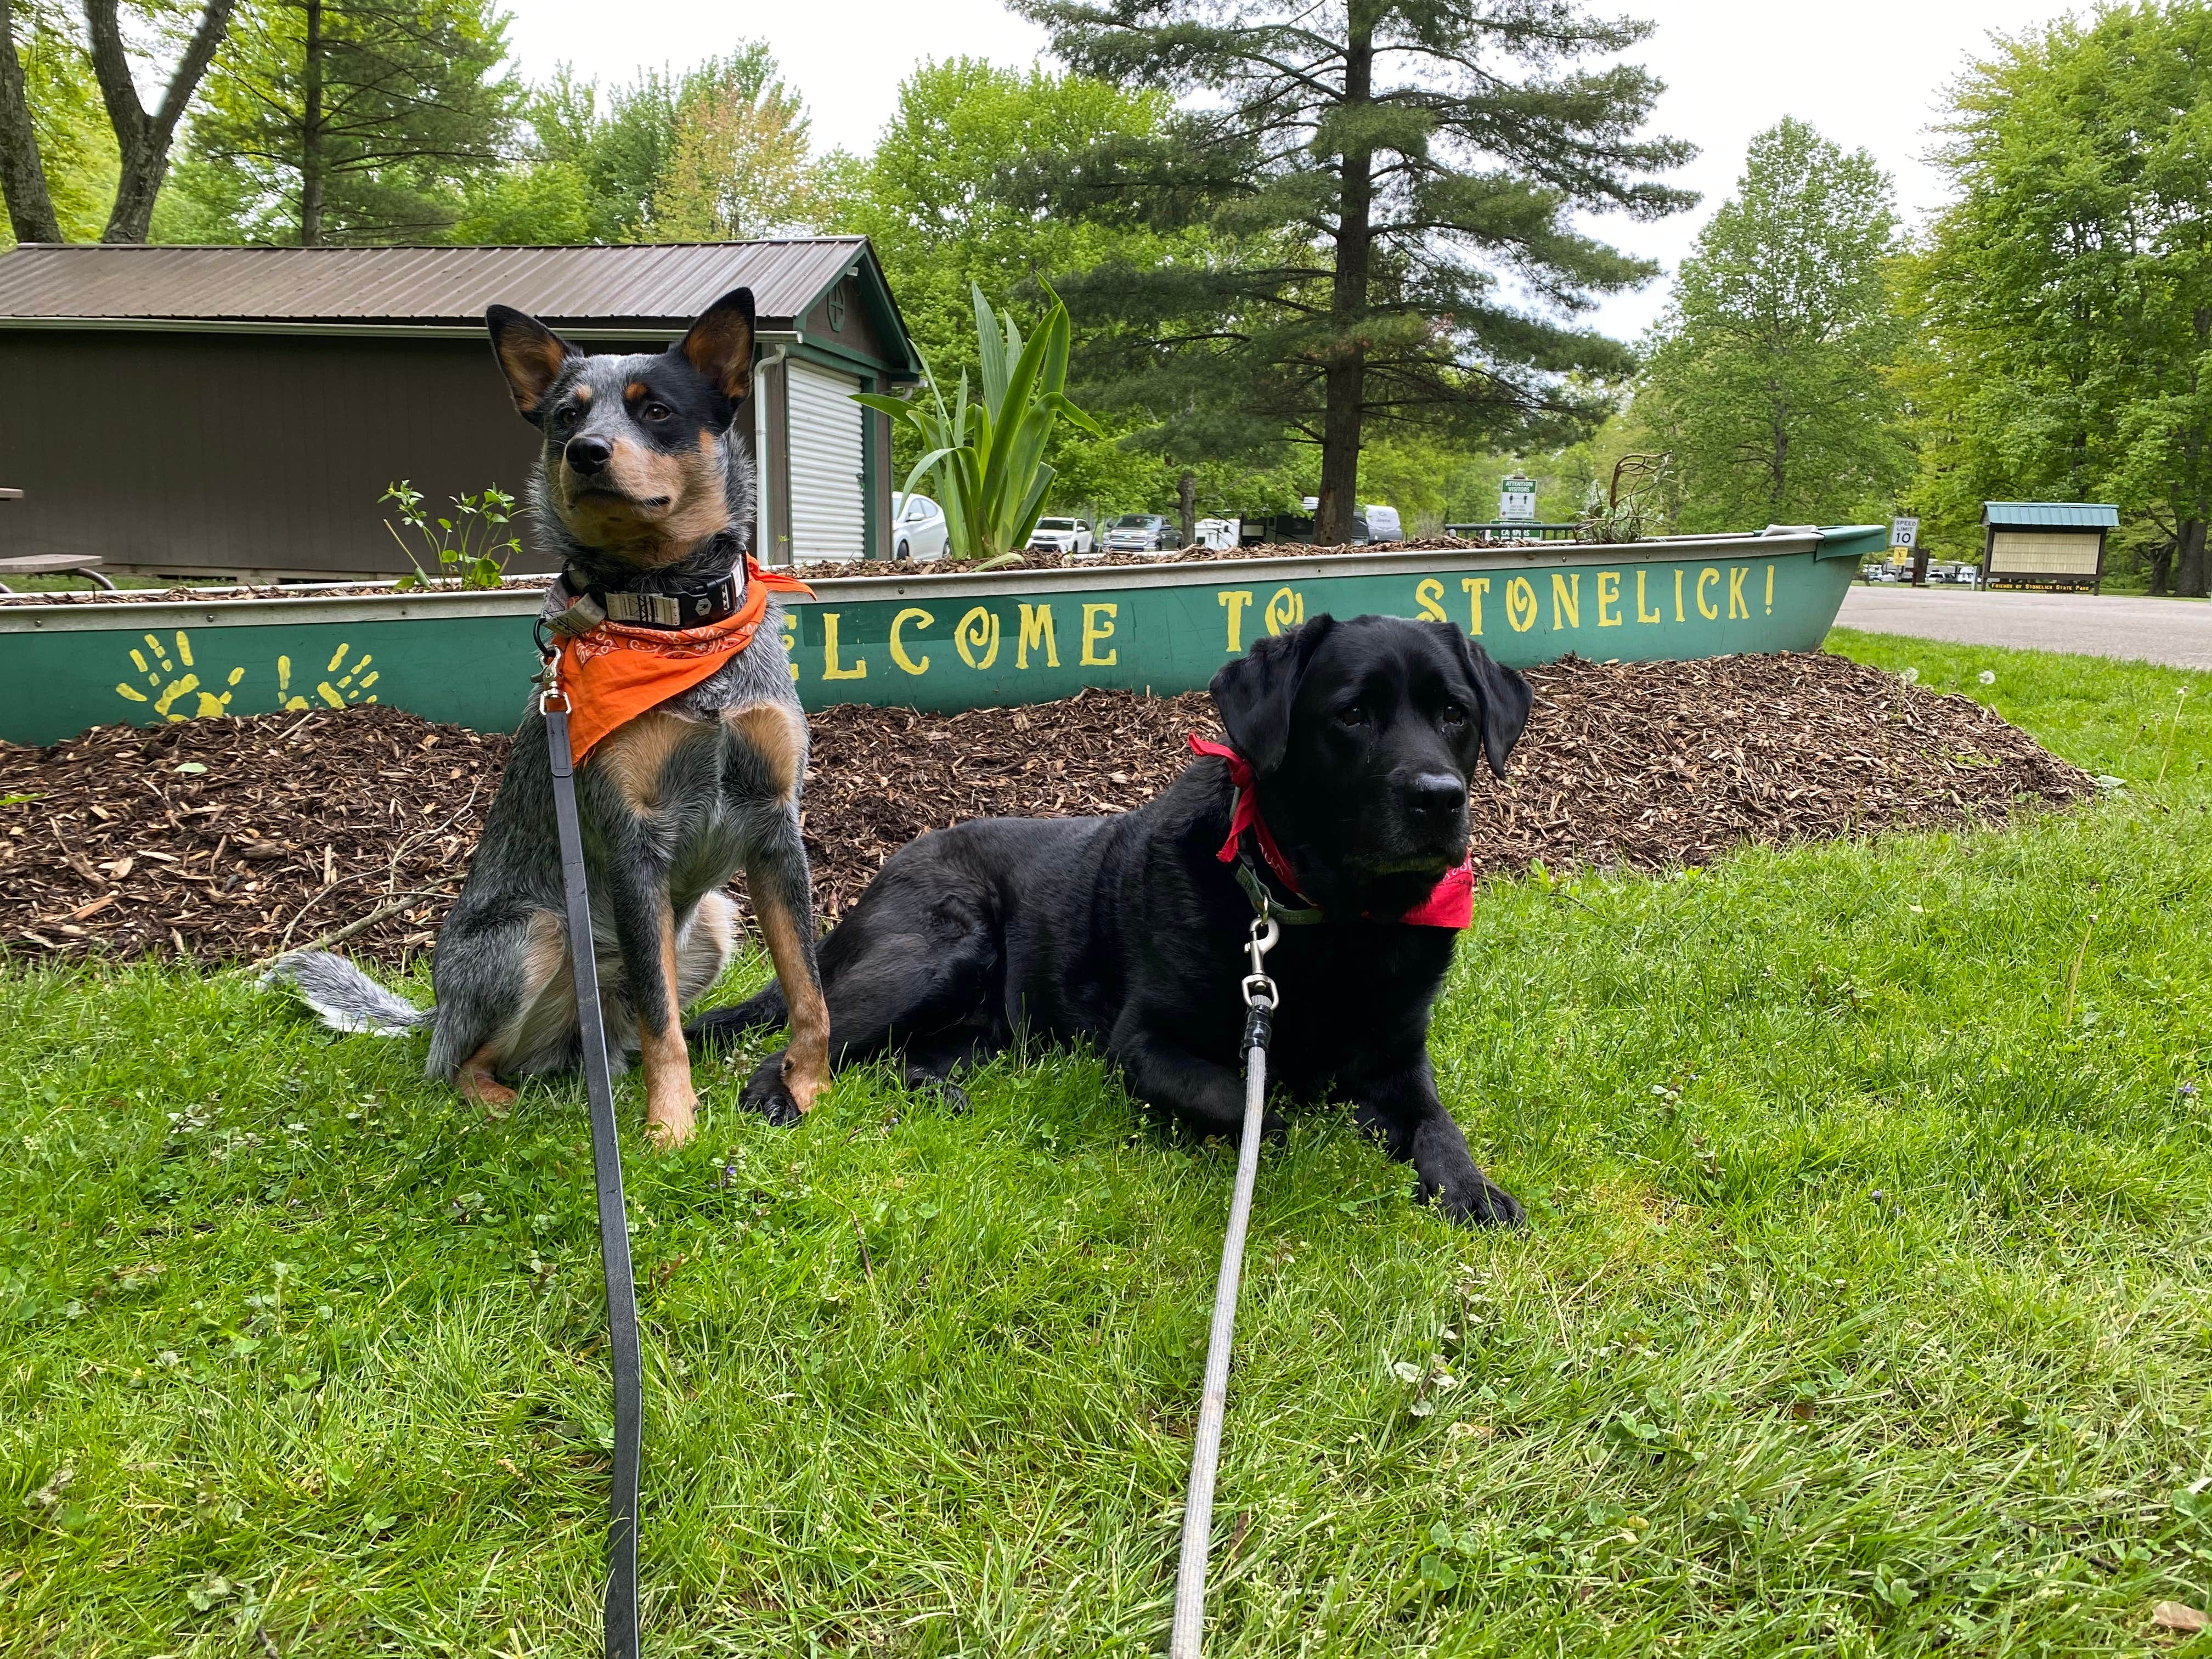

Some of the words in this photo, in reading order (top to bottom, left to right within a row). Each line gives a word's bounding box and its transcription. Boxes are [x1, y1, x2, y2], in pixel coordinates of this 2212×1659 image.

[1897, 533, 1911, 543] 10
[783, 603, 1118, 680] LCOME
[1217, 586, 1304, 652] TO
[1415, 565, 1775, 636] STONELICK!
